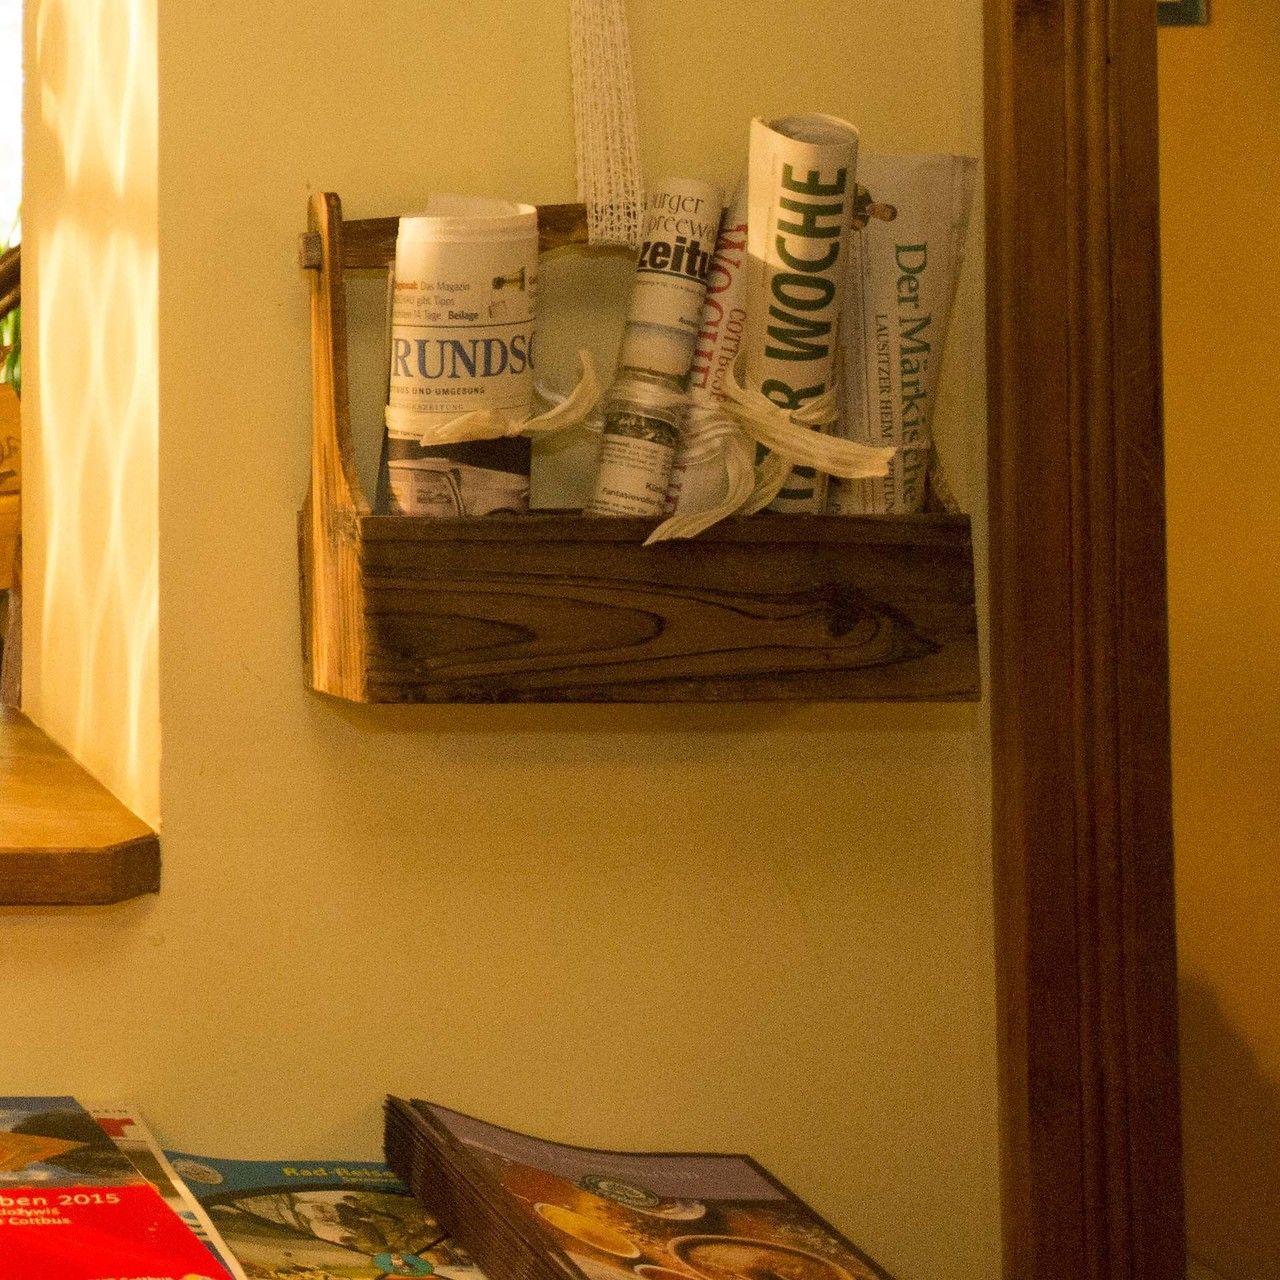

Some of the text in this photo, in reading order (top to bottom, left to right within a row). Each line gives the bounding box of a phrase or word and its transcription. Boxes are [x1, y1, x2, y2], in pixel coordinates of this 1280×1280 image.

[896, 241, 928, 311] Der
[448, 310, 479, 322] Beilage
[411, 386, 432, 395] UND
[434, 387, 486, 396] UMGEBUNG
[56, 1192, 120, 1206] 2015
[7, 1217, 73, 1226] Cottbus
